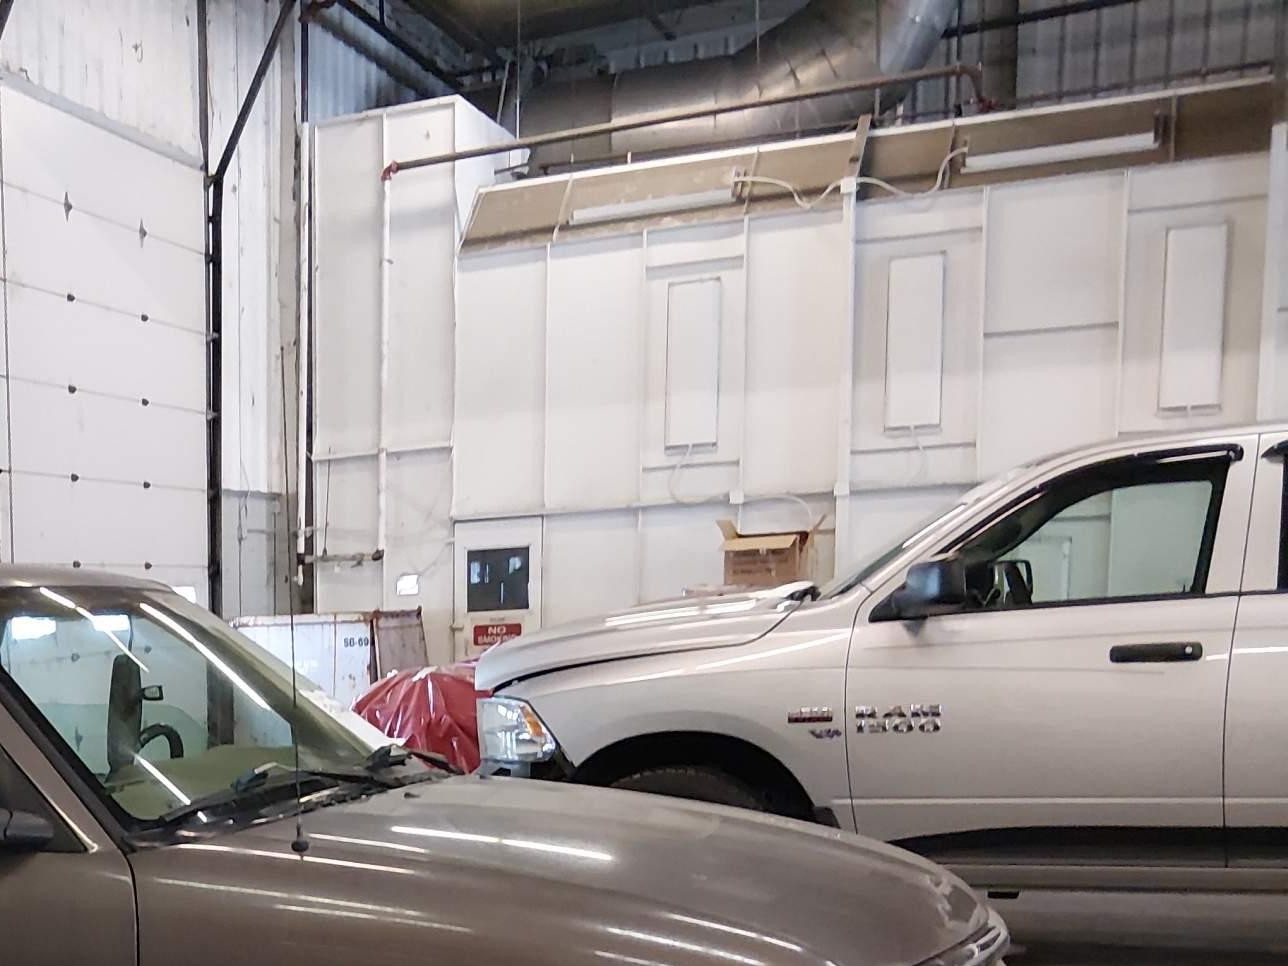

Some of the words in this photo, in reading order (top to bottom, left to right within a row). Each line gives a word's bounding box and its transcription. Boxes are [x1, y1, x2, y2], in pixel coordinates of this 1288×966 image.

[488, 626, 506, 635] NO
[855, 704, 941, 719] RAM
[856, 719, 941, 733] 1500
